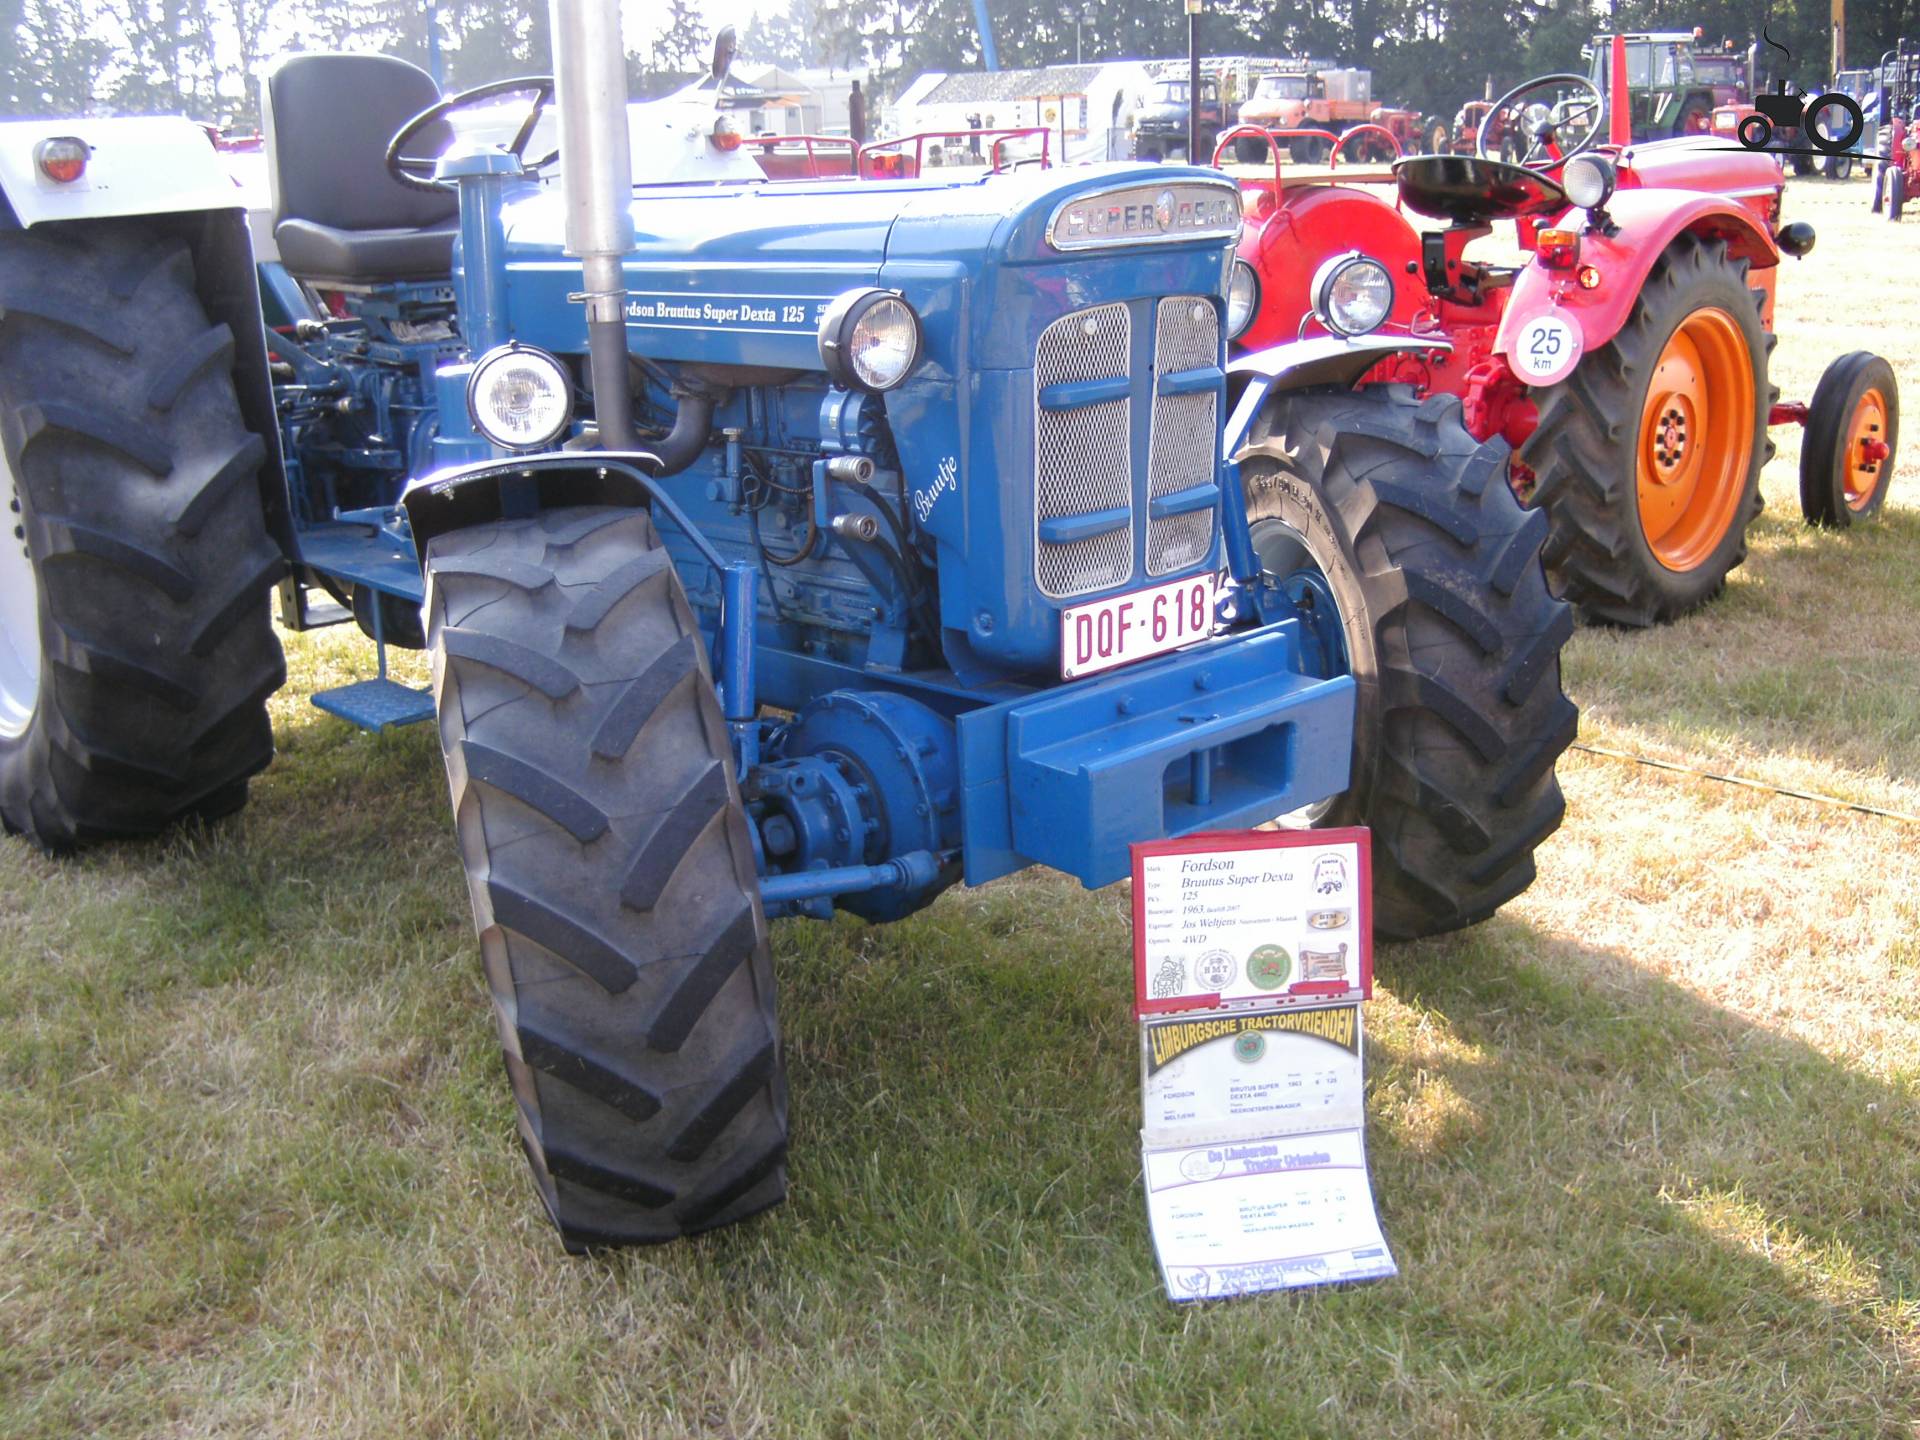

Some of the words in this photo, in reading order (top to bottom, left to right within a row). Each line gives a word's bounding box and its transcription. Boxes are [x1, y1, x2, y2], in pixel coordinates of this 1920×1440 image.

[1068, 204, 1154, 236] SUPER
[1179, 200, 1233, 227] DEXTA
[625, 302, 655, 317] rdson
[656, 304, 701, 319] Bruutus
[703, 303, 738, 323] Super
[740, 305, 776, 322] Dexta
[782, 306, 805, 322] 125
[1530, 328, 1562, 355] 25
[1533, 357, 1551, 369] km
[914, 456, 957, 522] Bruutje
[1181, 858, 1235, 873] Fordson
[1181, 877, 1224, 889] Bruutus
[1227, 874, 1258, 887] Super
[1262, 872, 1294, 883] Dexta
[1182, 891, 1199, 901] 125
[1181, 920, 1196, 930] Jos
[1199, 918, 1237, 929] Weltjens
[1182, 934, 1207, 944] 4WD
[1150, 1020, 1237, 1066] LIMBURGSCHE
[1239, 1008, 1355, 1046] TRACTORVRIENDEN
